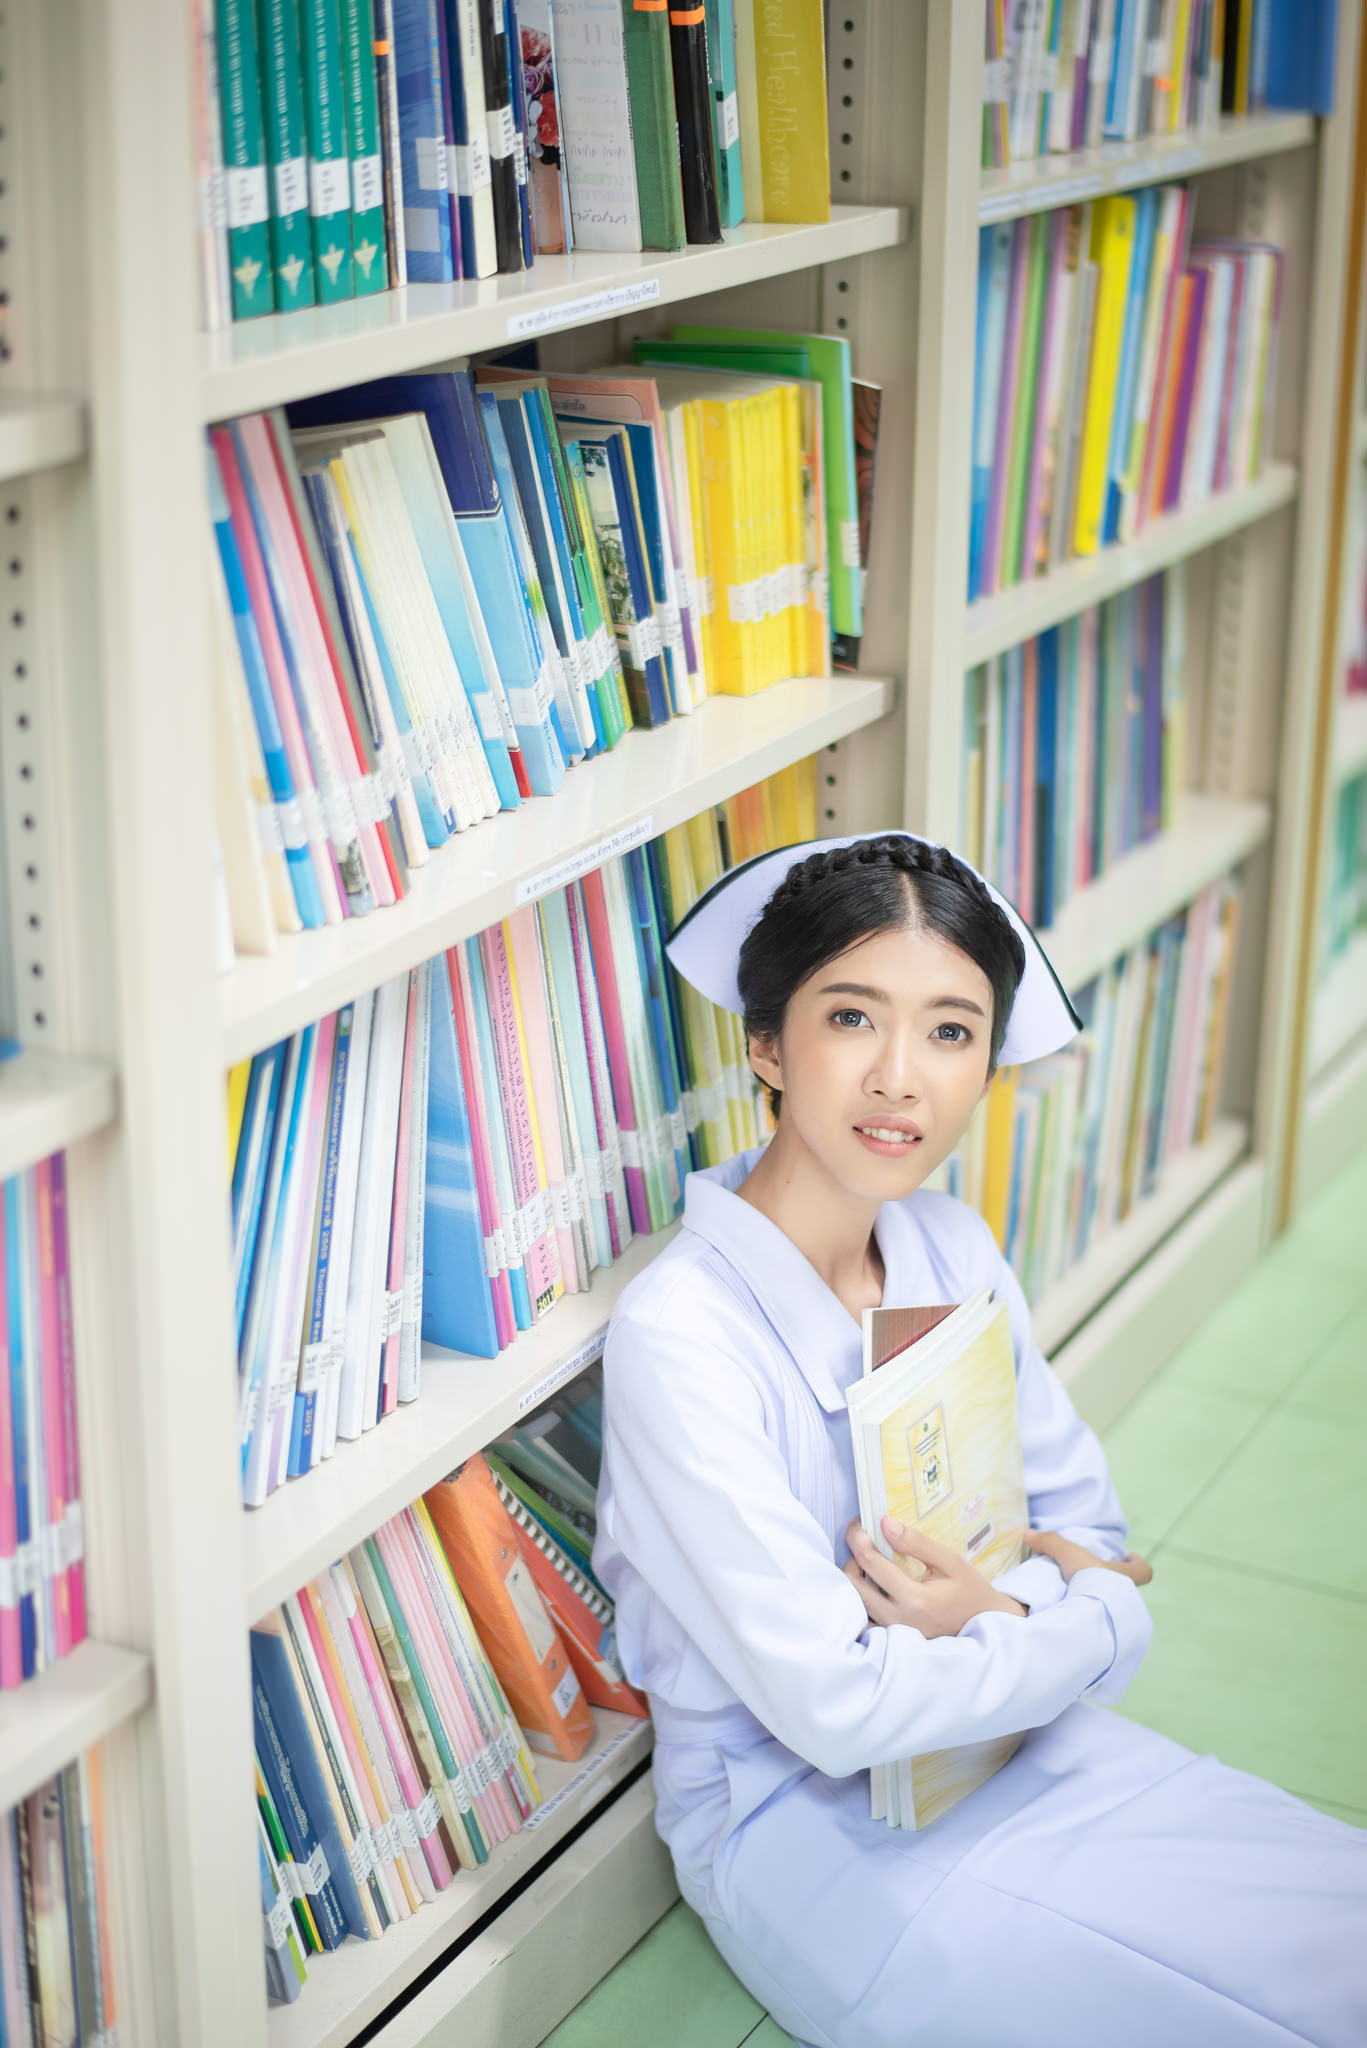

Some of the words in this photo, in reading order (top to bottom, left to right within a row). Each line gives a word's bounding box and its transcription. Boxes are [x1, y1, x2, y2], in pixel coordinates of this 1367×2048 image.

[764, 47, 799, 204] Healthcare
[497, 975, 506, 1012] Annual
[502, 1013, 517, 1098] Epidemiological
[513, 1099, 526, 1161] Surveillance
[521, 1163, 531, 1198] Report
[315, 1268, 325, 1317] Thailand
[537, 1291, 555, 1312] 2011
[304, 1410, 313, 1435] 2012
